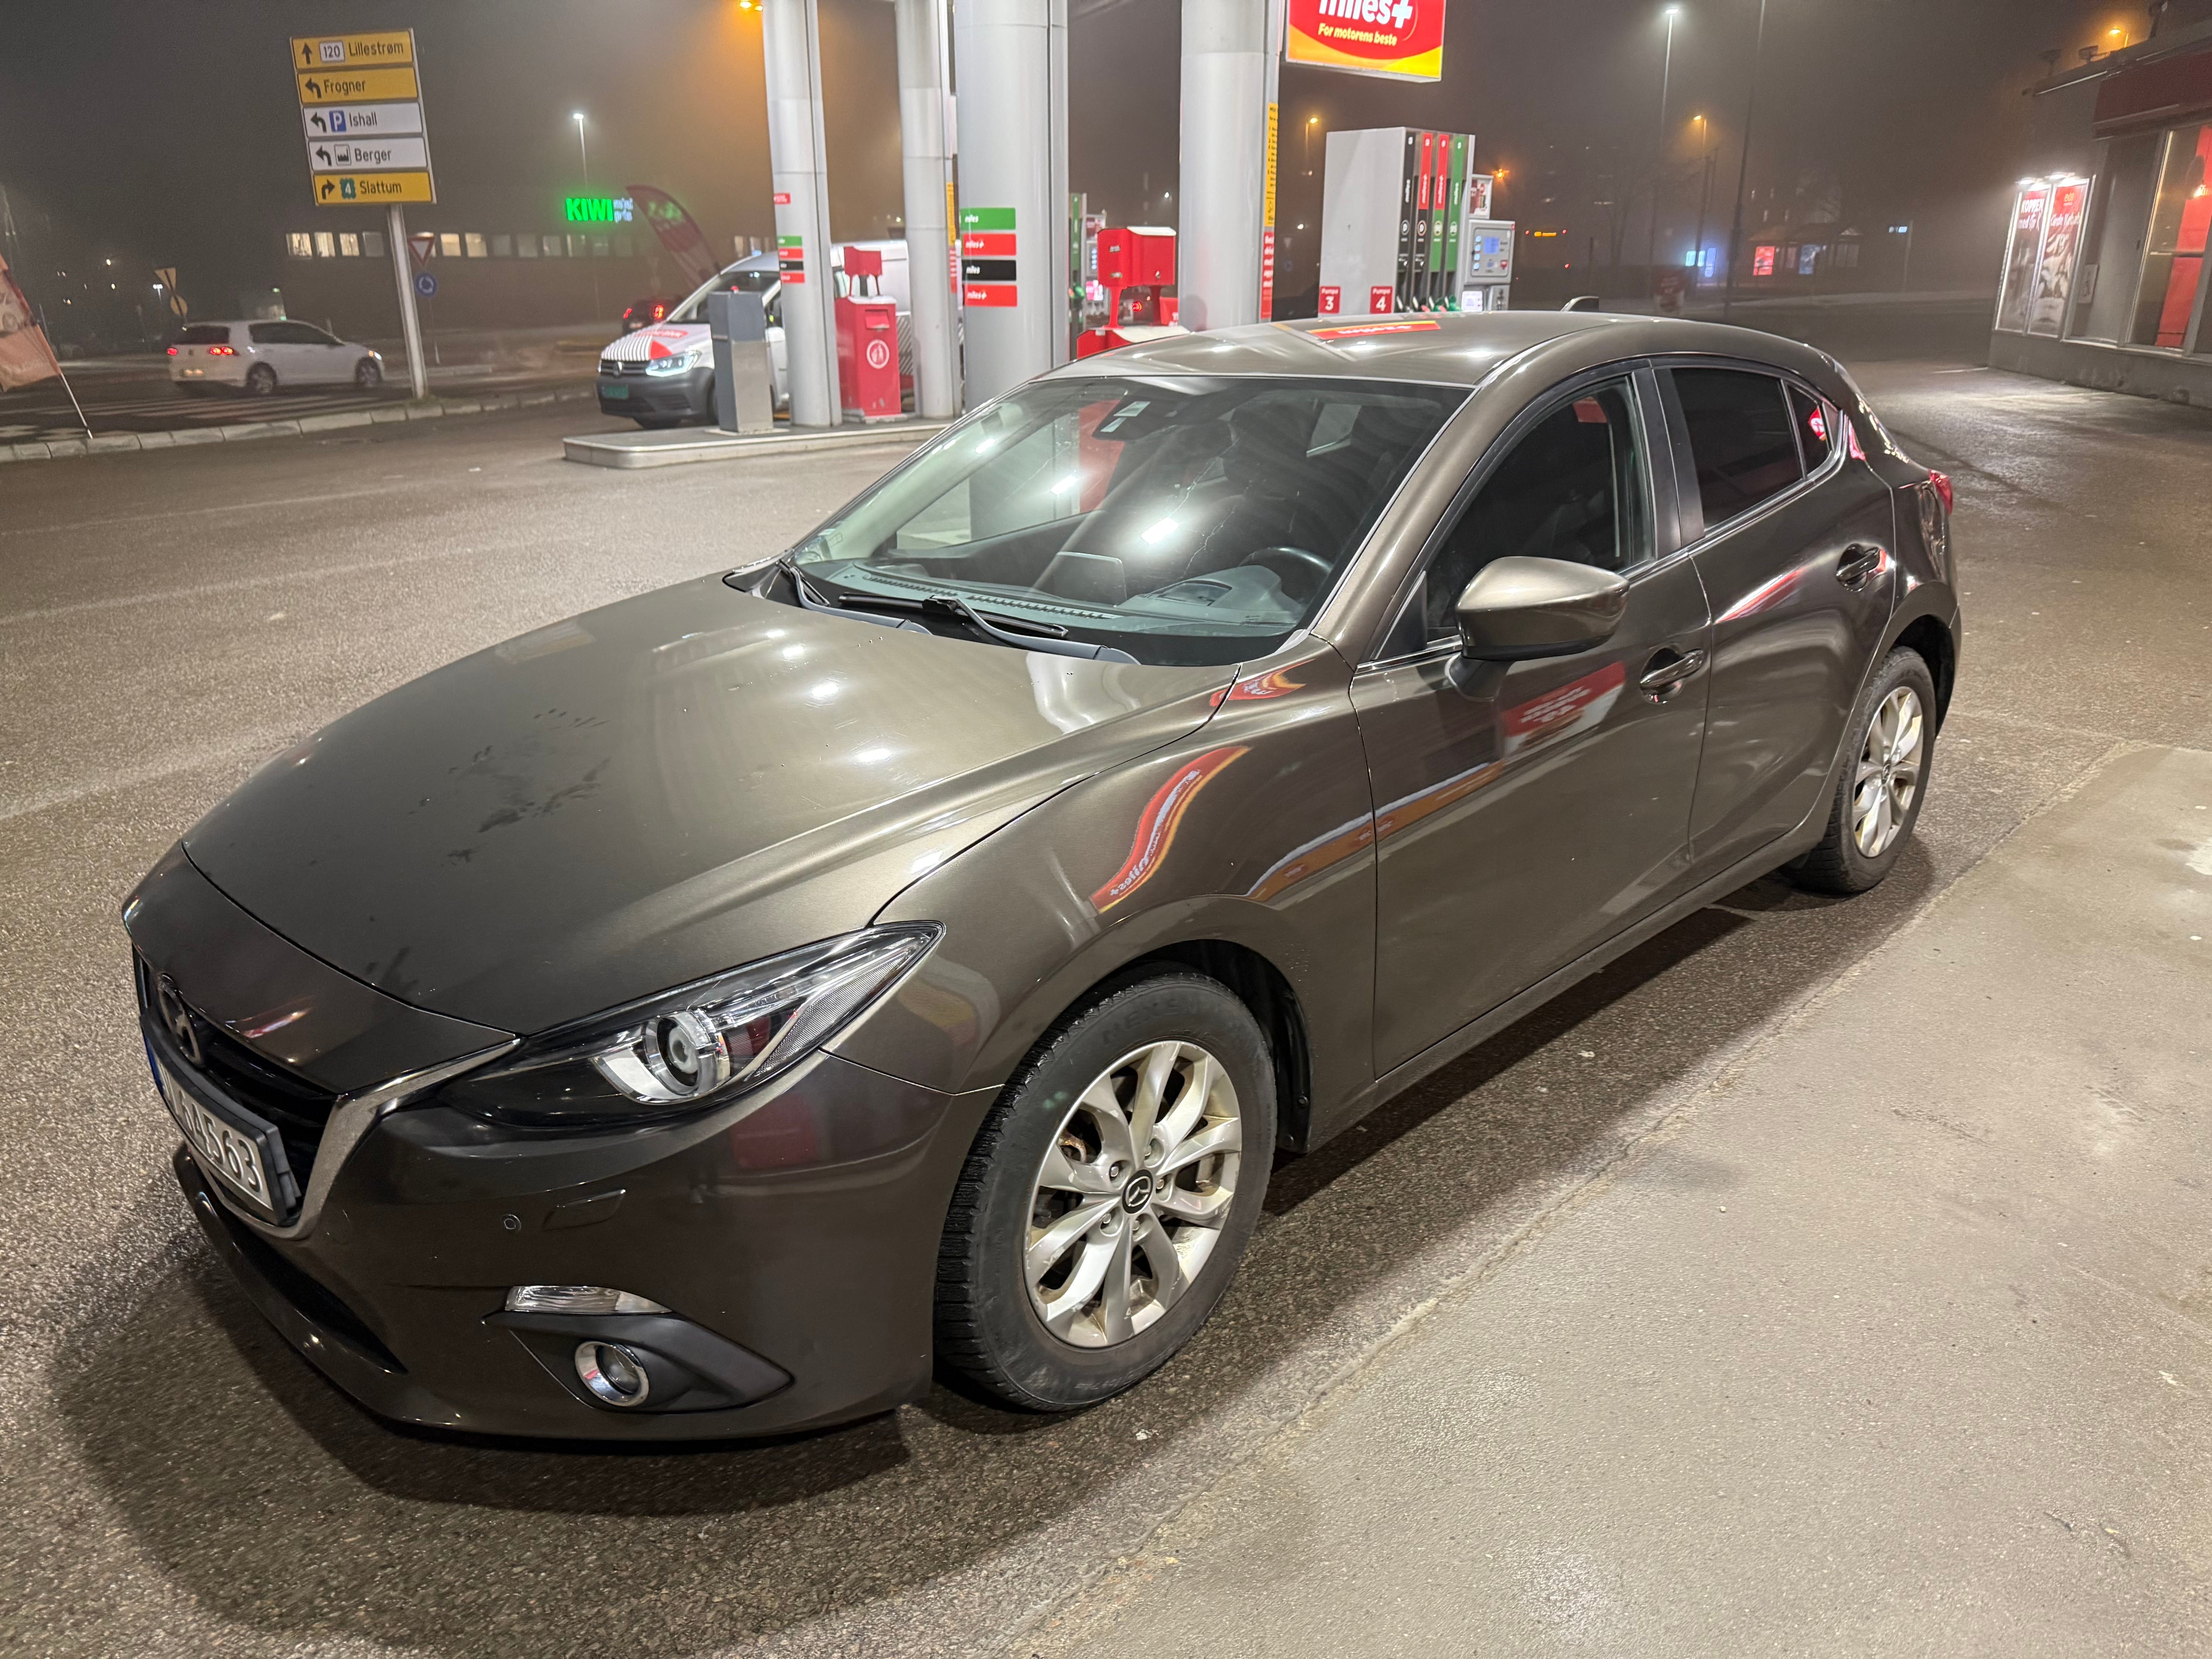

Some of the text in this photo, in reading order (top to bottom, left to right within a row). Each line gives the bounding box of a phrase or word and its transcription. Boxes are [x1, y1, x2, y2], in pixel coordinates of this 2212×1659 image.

[1318, 22, 1397, 46] For motorens beste
[323, 42, 404, 58] 120 Lillestrøm
[324, 79, 366, 95] Frogner
[333, 112, 378, 131] P Ishall
[354, 148, 392, 164] Berger
[360, 182, 402, 195] Slattum
[566, 198, 613, 221] KIWI
[2021, 198, 2045, 213] KOPPEN
[965, 215, 979, 223] miles
[966, 265, 980, 274] miles
[1325, 296, 1334, 311] 3
[1376, 295, 1386, 311] 4
